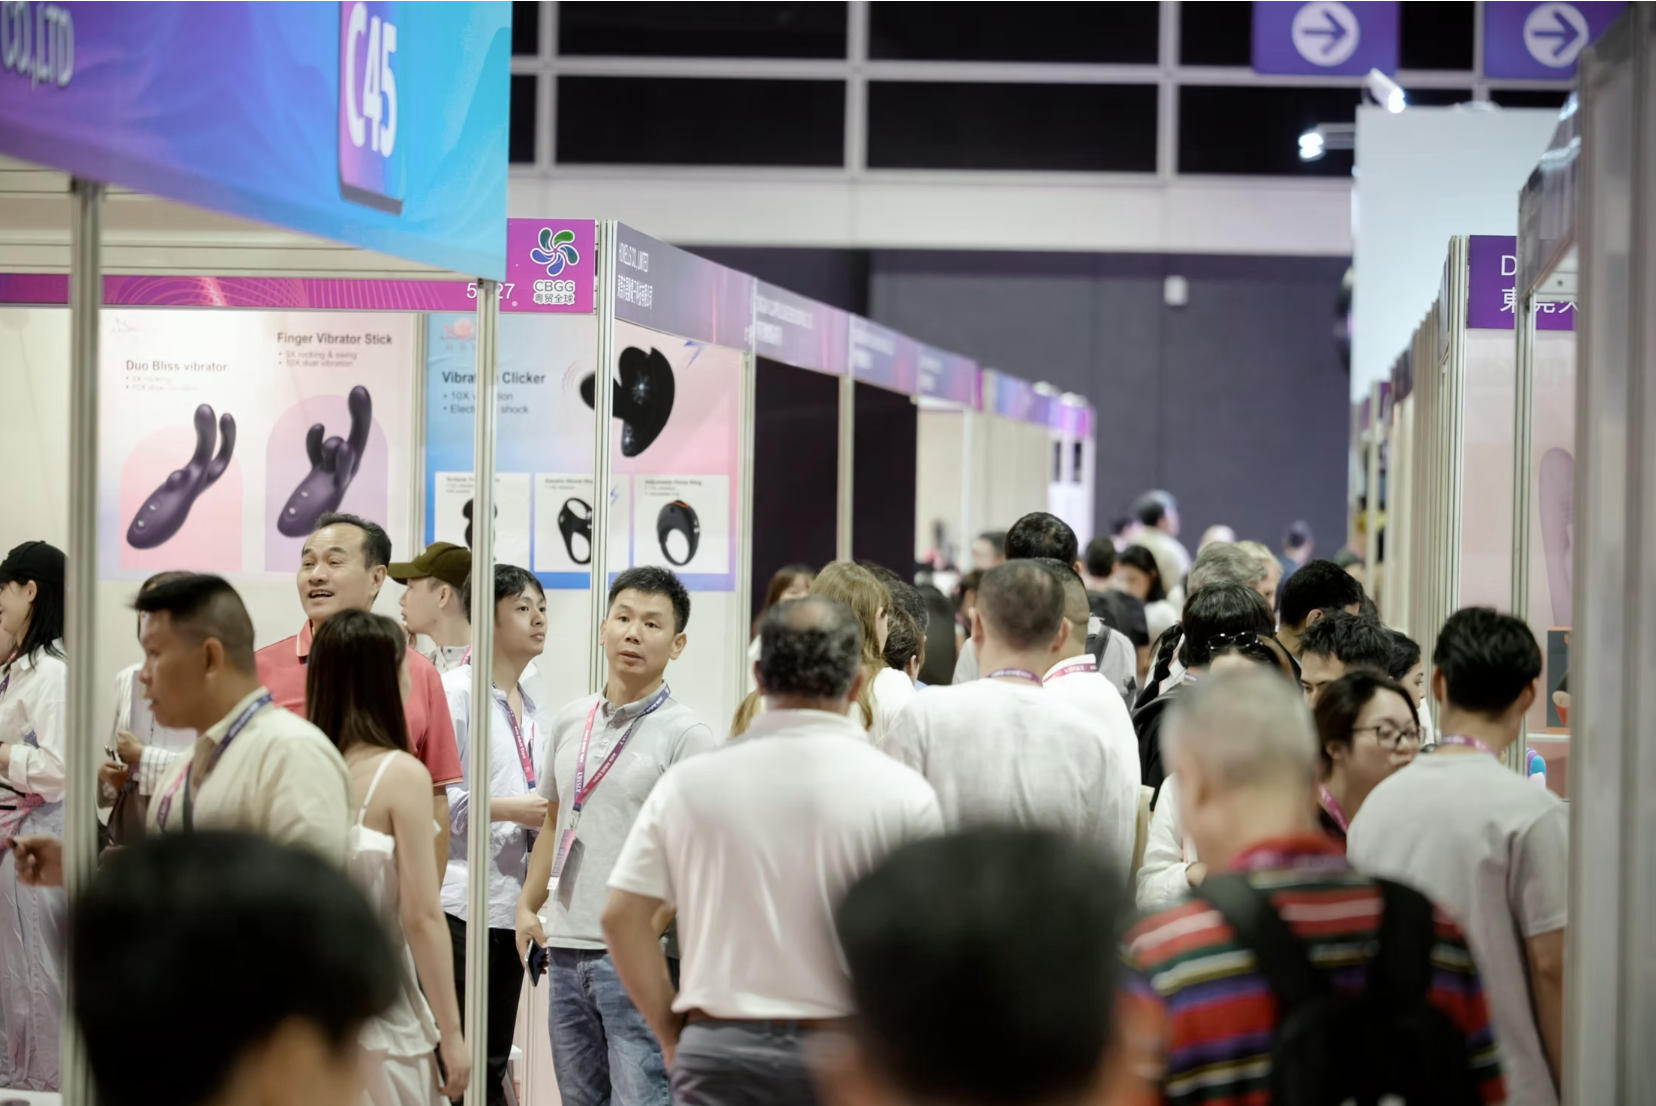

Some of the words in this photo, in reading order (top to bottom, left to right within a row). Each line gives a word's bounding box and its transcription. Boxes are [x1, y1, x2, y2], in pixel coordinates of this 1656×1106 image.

[347, 1, 398, 158] C45
[533, 280, 575, 293] CBGG
[276, 332, 313, 346] Finger
[316, 332, 361, 344] Vibrator
[364, 333, 393, 345] Stick
[126, 360, 149, 371] Duo
[152, 360, 180, 371] Bliss
[183, 362, 227, 372] vibrator
[502, 371, 547, 384] Clicker
